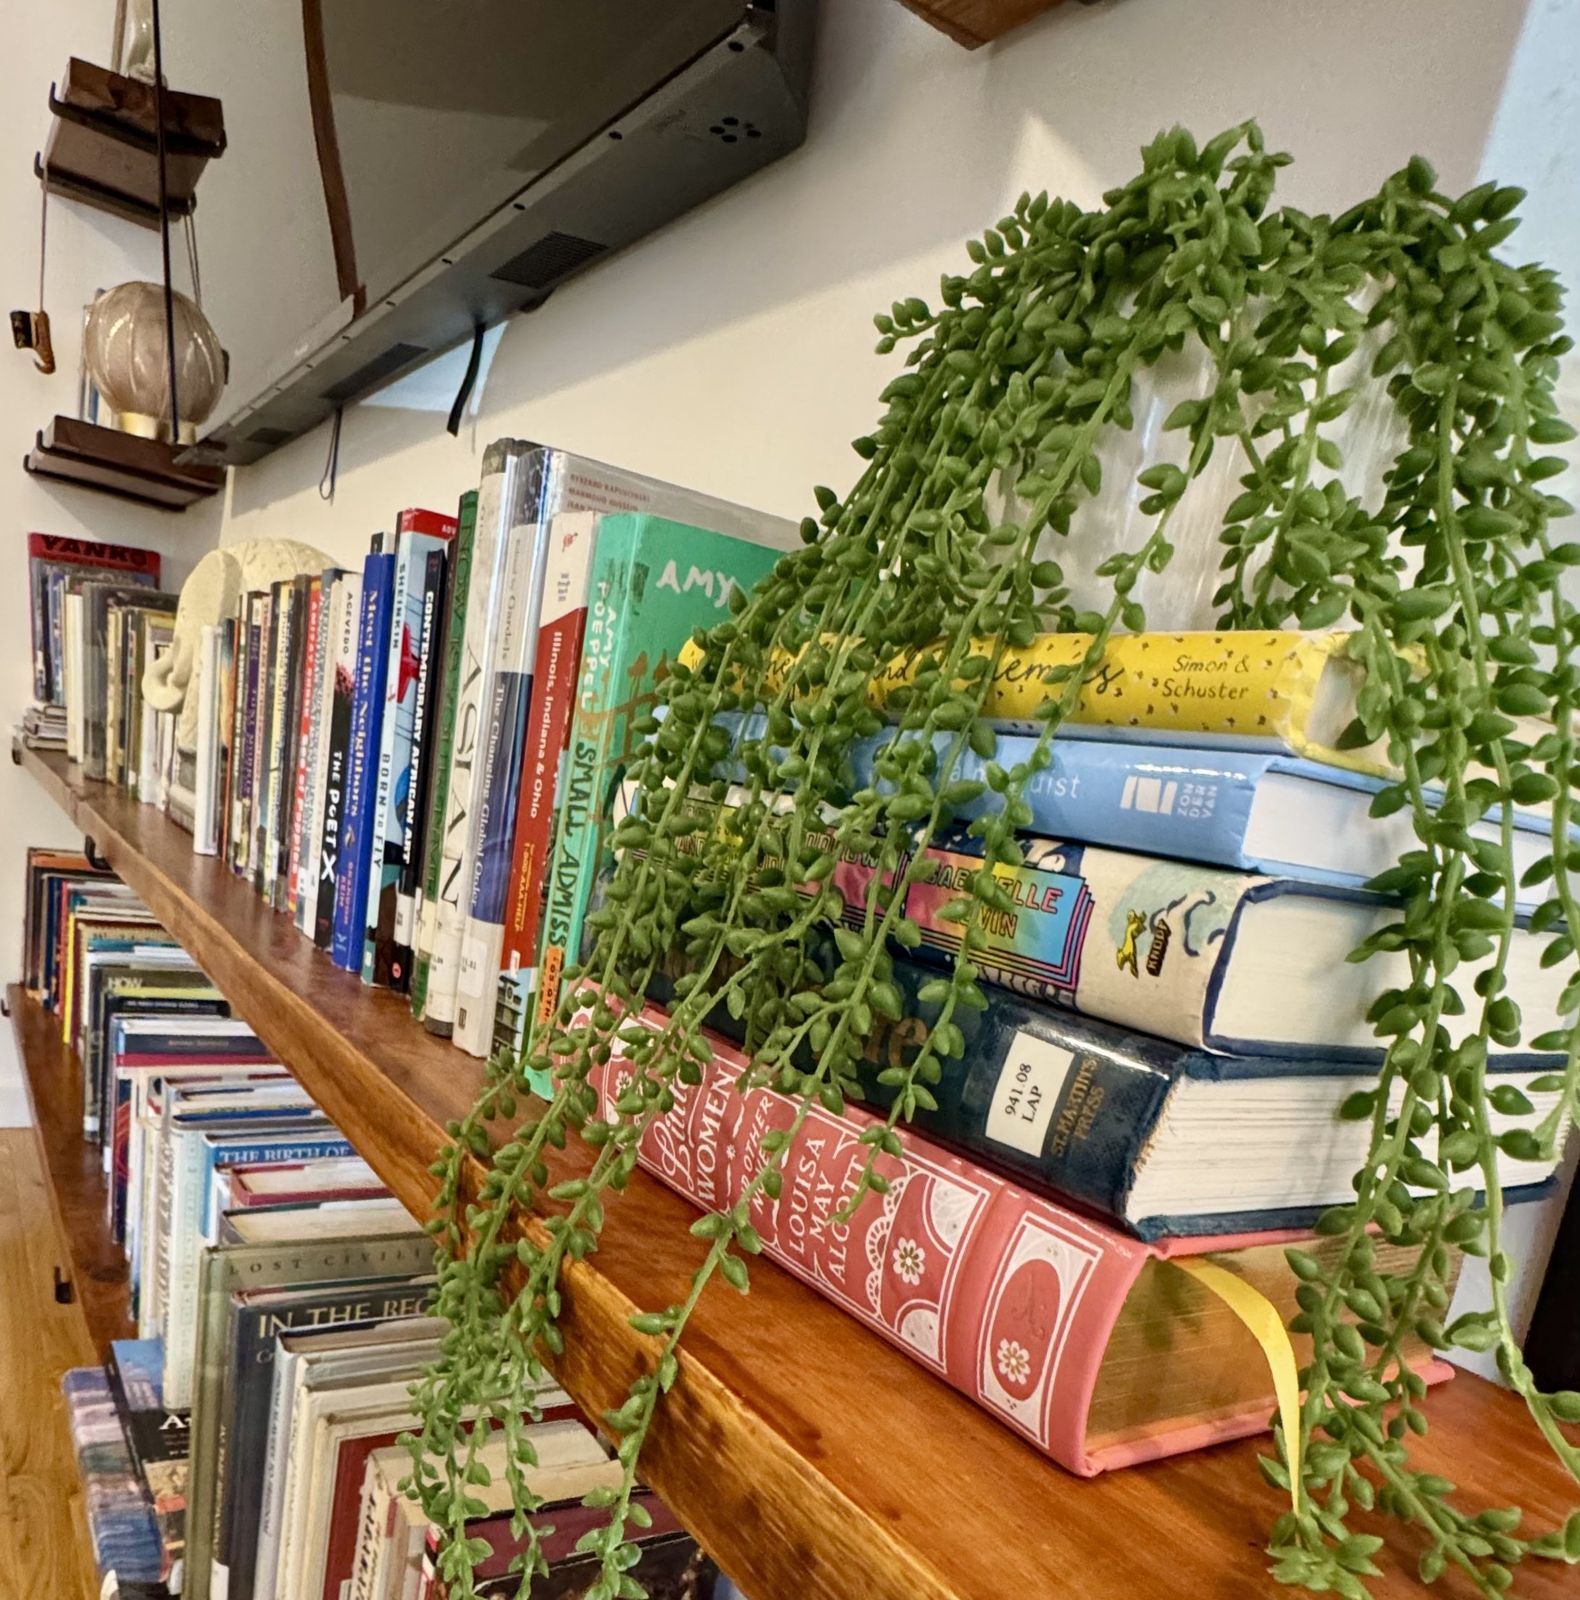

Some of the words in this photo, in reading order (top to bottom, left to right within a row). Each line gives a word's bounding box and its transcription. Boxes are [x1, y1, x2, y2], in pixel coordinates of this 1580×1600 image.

[392, 563, 406, 649] SHEINKIN
[656, 559, 737, 608] AMY
[343, 593, 354, 655] ACEVEDO
[364, 590, 379, 648] Meet
[502, 595, 517, 661] Gardels
[581, 582, 607, 709] POEPPEL
[598, 607, 618, 668] AMY
[361, 657, 373, 694] the
[412, 591, 434, 741] CONTEMPORARY
[546, 632, 563, 691] Illinois,
[1172, 654, 1228, 674] Simon
[1233, 658, 1250, 674] &
[493, 683, 505, 718] The
[1162, 677, 1249, 700] Schuster
[537, 696, 555, 758] Indiana
[331, 751, 342, 783] THE
[351, 701, 369, 817] Neighbors
[378, 753, 391, 806] BORN
[405, 746, 420, 824] AFRICAN
[442, 643, 482, 911] ASIAN
[482, 721, 501, 798] Changing
[535, 764, 545, 775] &
[530, 778, 544, 819] Ohio
[565, 742, 596, 837] SMALL
[377, 813, 385, 828] TO
[402, 827, 414, 864] ART
[475, 803, 492, 856] Global
[320, 850, 336, 884] X
[373, 834, 384, 870] FLY
[470, 860, 484, 908] Order
[108, 977, 143, 989] HOW
[1005, 1063, 1032, 1116] 941.08
[1022, 1086, 1043, 1123] LAP
[1073, 1086, 1105, 1141] PRESS
[218, 1150, 260, 1162] THE
[264, 1147, 323, 1161] BIRTH
[326, 1145, 350, 1157] OF
[697, 1067, 736, 1201] WOMEN
[743, 1096, 774, 1171] OTHER
[788, 1137, 826, 1255] LOUISA
[810, 1172, 835, 1243] MAY
[229, 1257, 301, 1276] LOST
[259, 1311, 293, 1338] IN
[306, 1302, 371, 1326] THE
